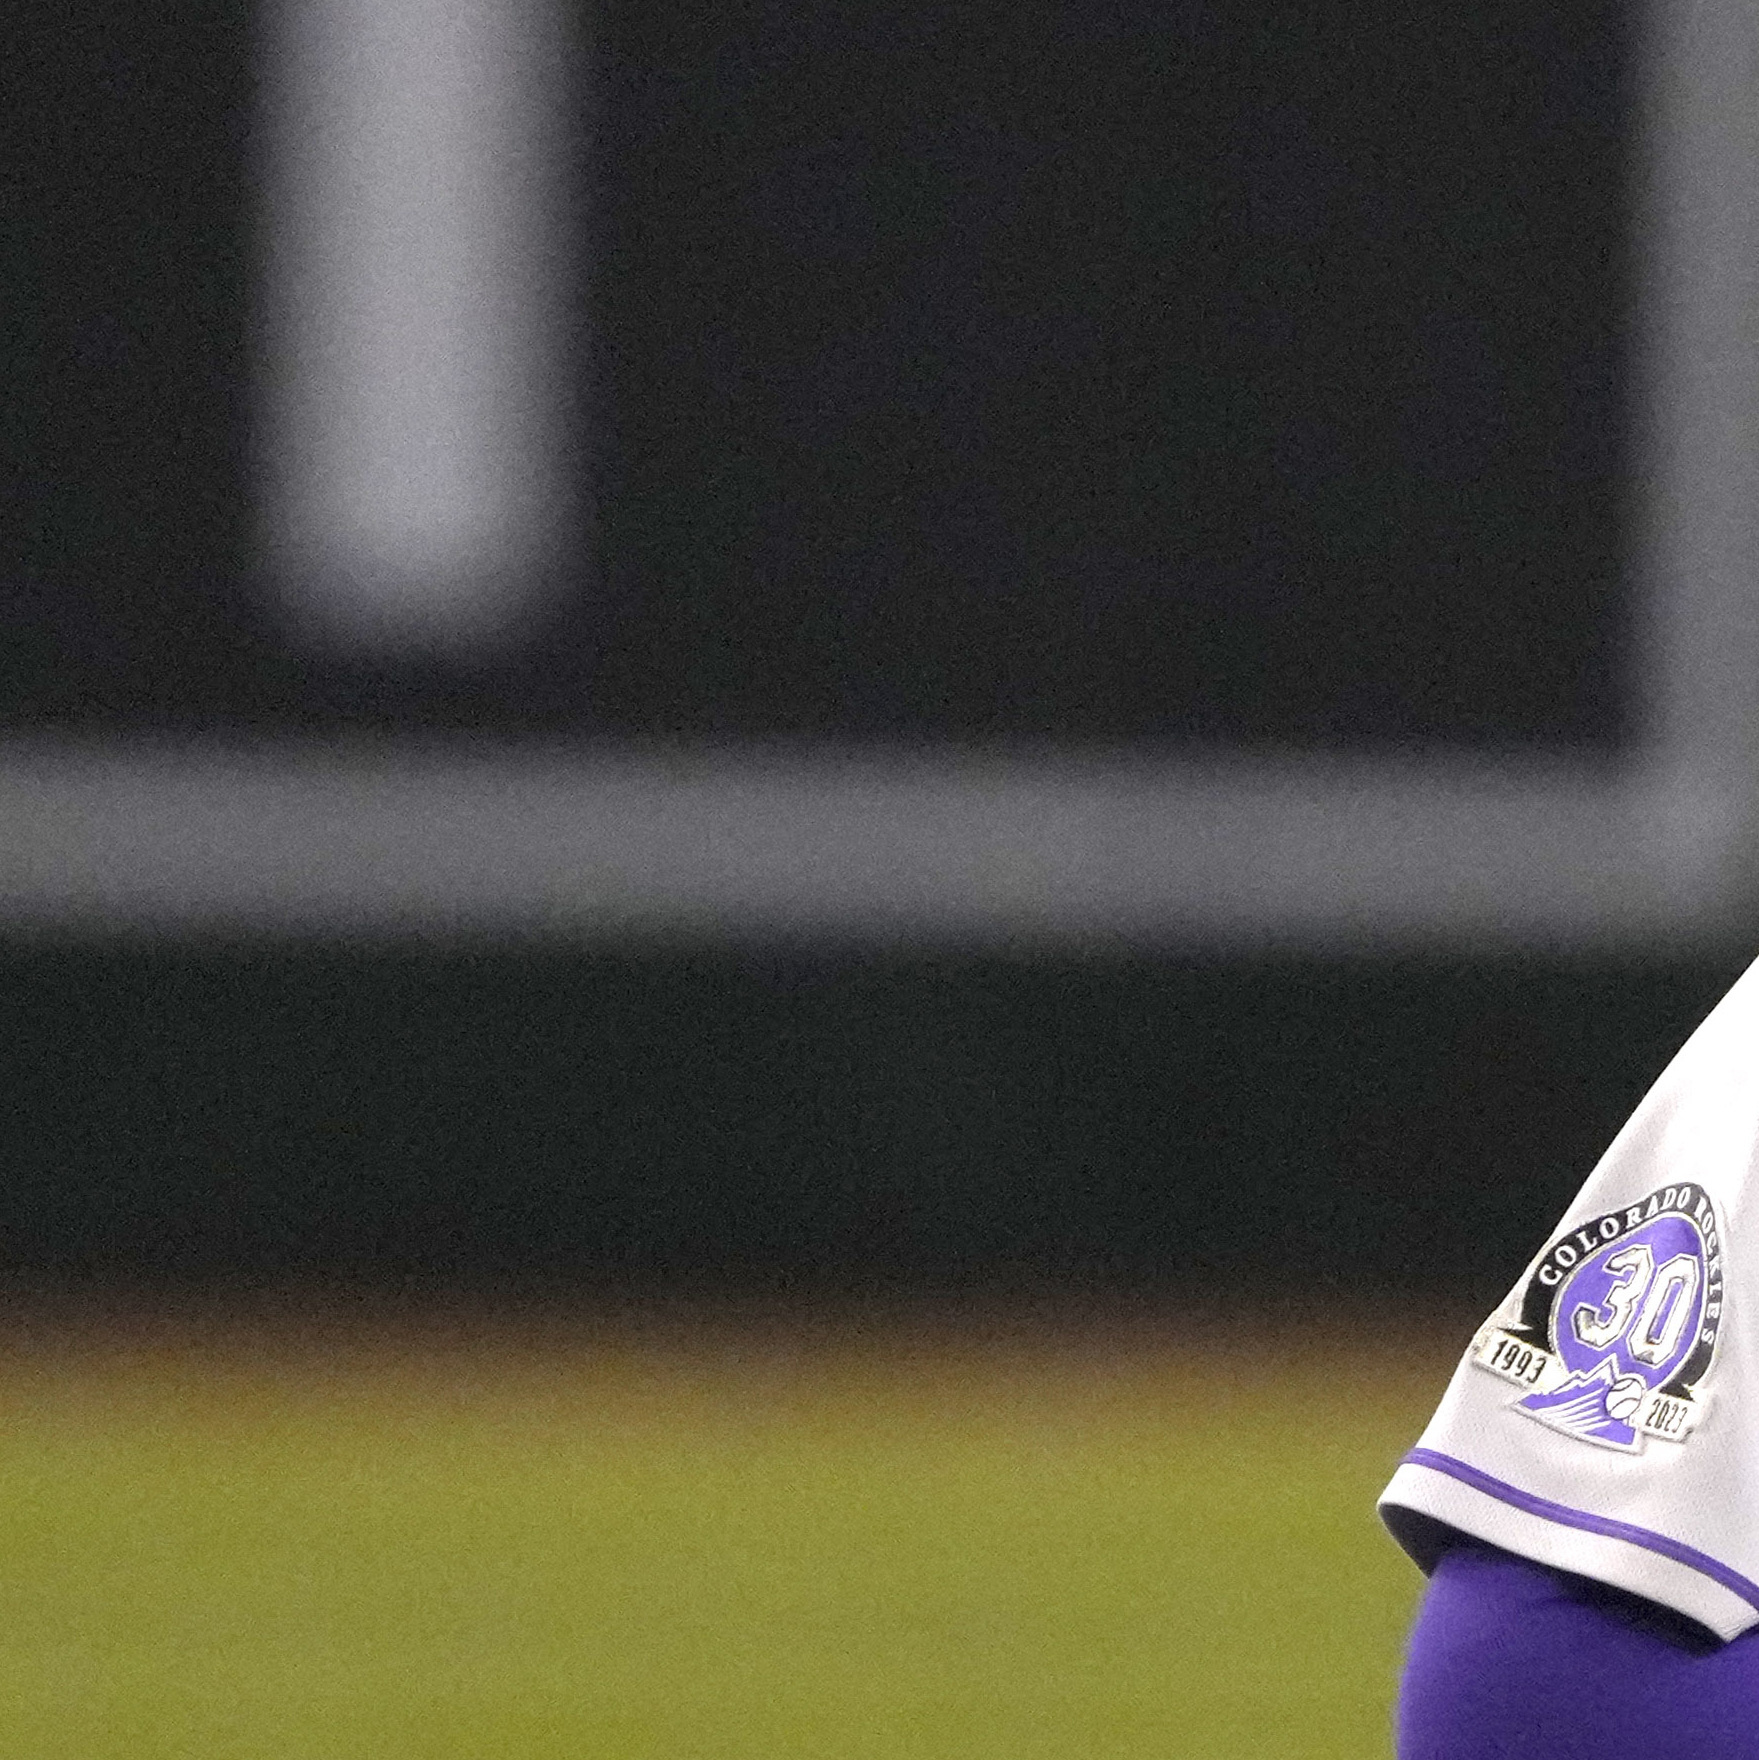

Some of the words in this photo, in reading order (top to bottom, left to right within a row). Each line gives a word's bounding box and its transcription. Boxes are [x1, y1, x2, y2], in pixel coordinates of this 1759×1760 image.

[1538, 1186, 1692, 1286] COLORADO
[1694, 1196, 1722, 1345] ROCKIES
[1571, 1243, 1700, 1369] 30
[1489, 1338, 1547, 1385] 1993
[1645, 1398, 1688, 1433] 2023
